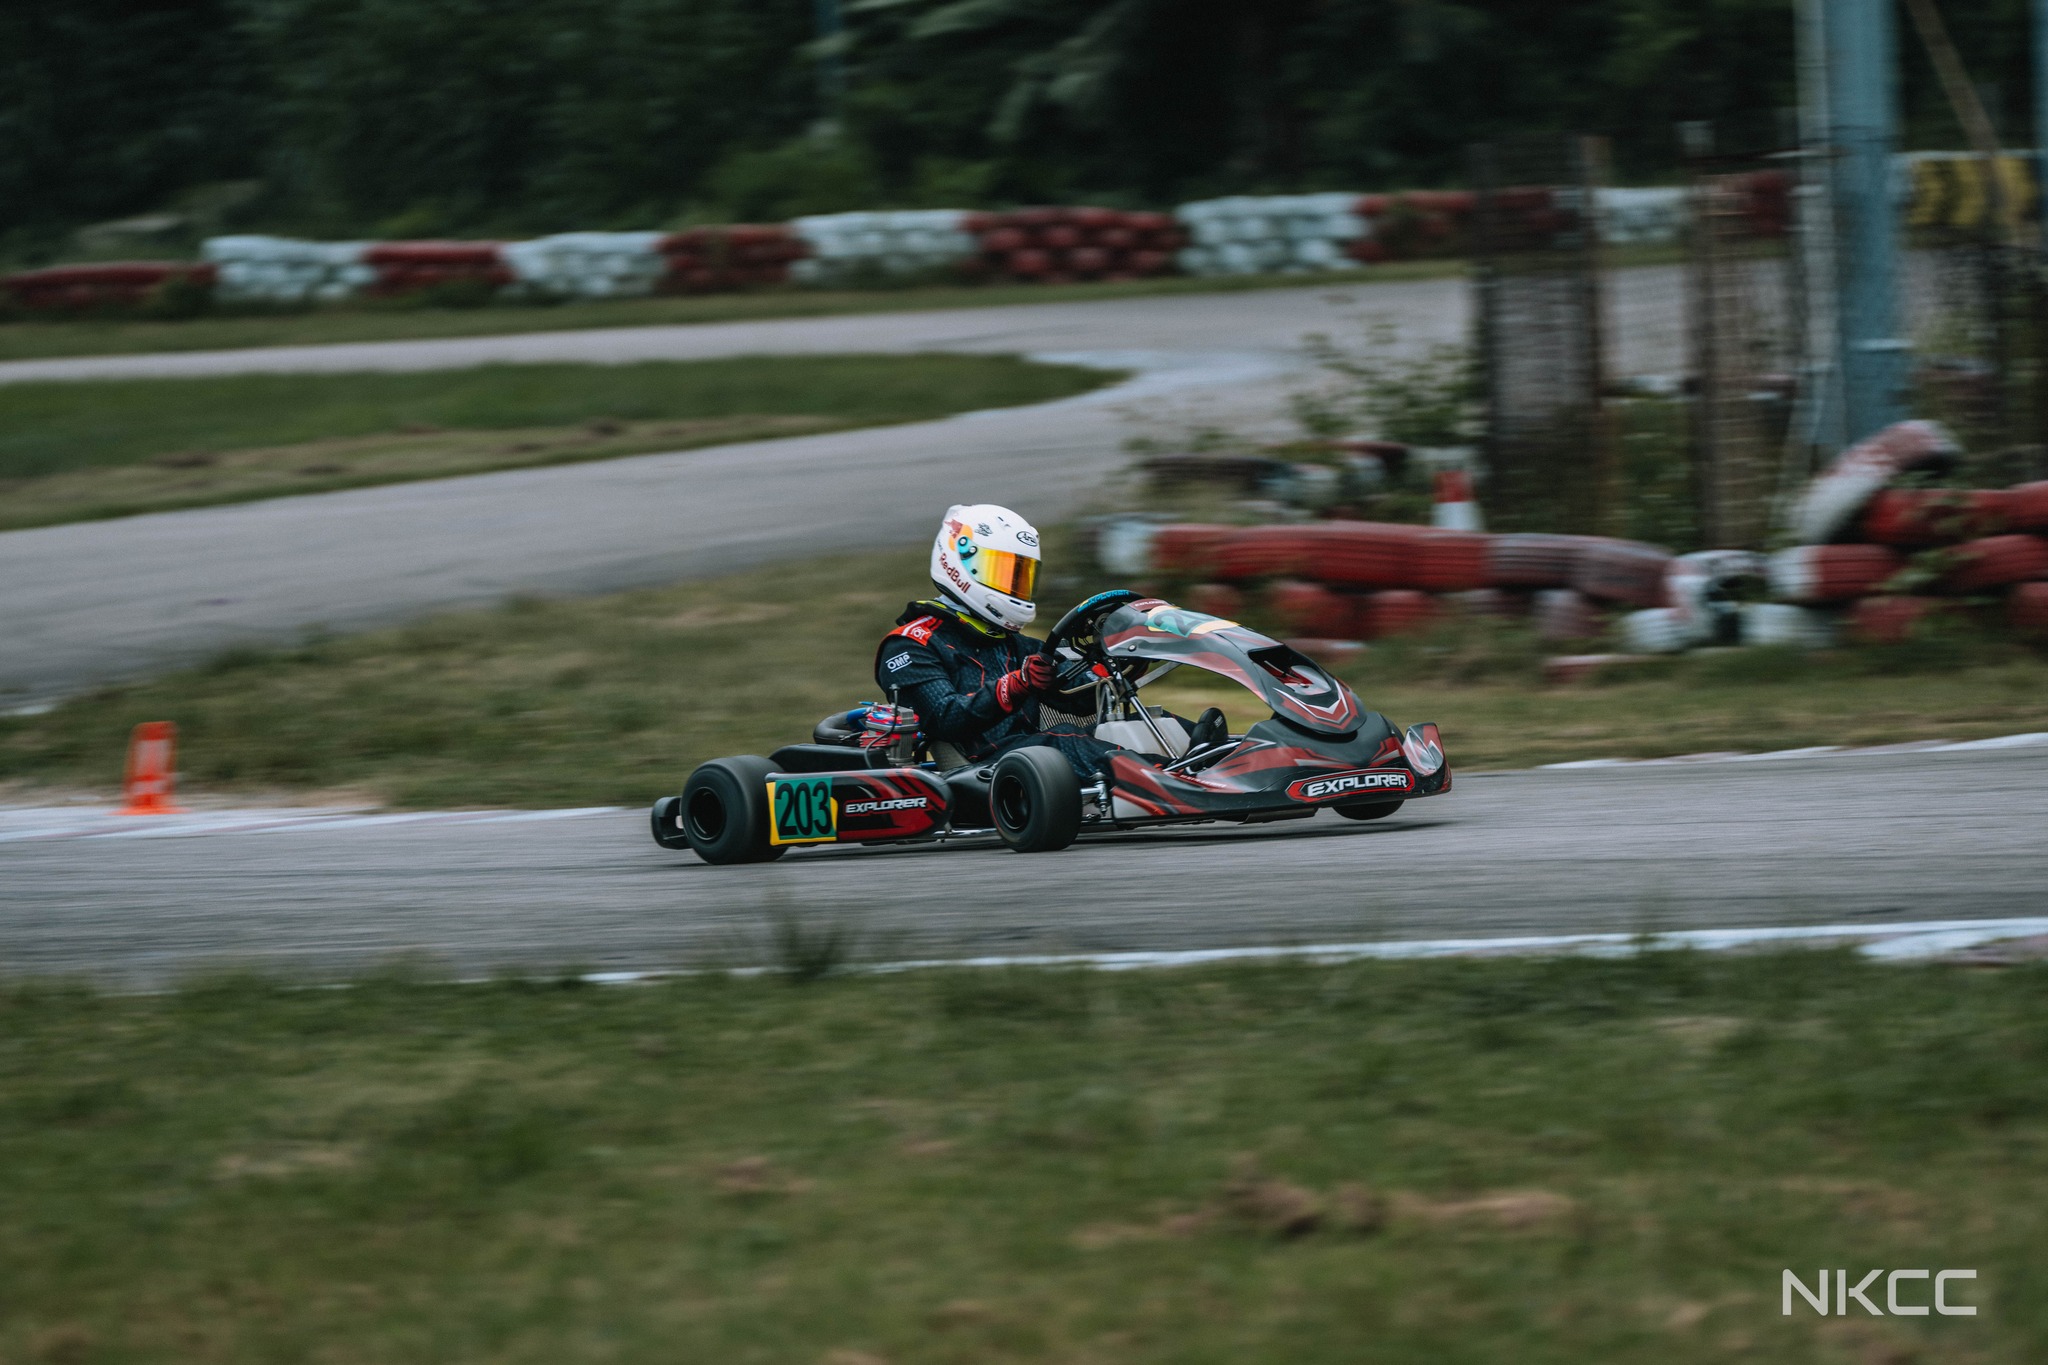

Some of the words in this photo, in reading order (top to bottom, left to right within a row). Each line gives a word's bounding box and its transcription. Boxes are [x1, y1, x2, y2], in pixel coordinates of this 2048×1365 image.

[940, 553, 971, 593] RedBull
[887, 654, 910, 669] OMP
[1307, 774, 1407, 796] EXPLORER
[775, 781, 832, 836] 203
[845, 797, 927, 813] EXPLORER
